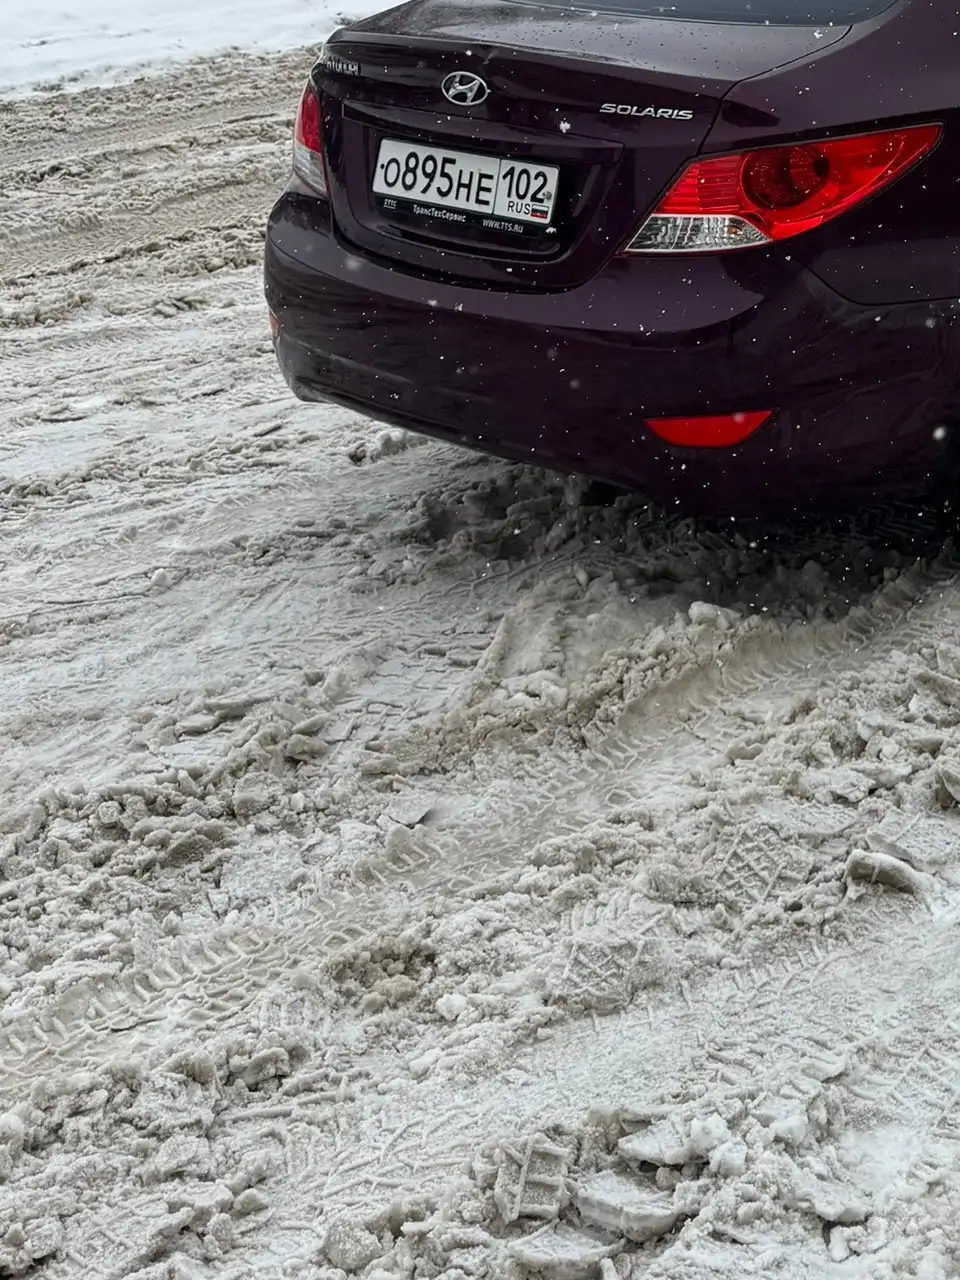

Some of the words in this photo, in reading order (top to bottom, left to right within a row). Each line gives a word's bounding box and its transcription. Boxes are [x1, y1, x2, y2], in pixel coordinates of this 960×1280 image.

[599, 103, 694, 120] SOLARIS
[502, 166, 548, 204] 102
[413, 204, 466, 223] ТрансТехСервис
[507, 200, 531, 215] RUS
